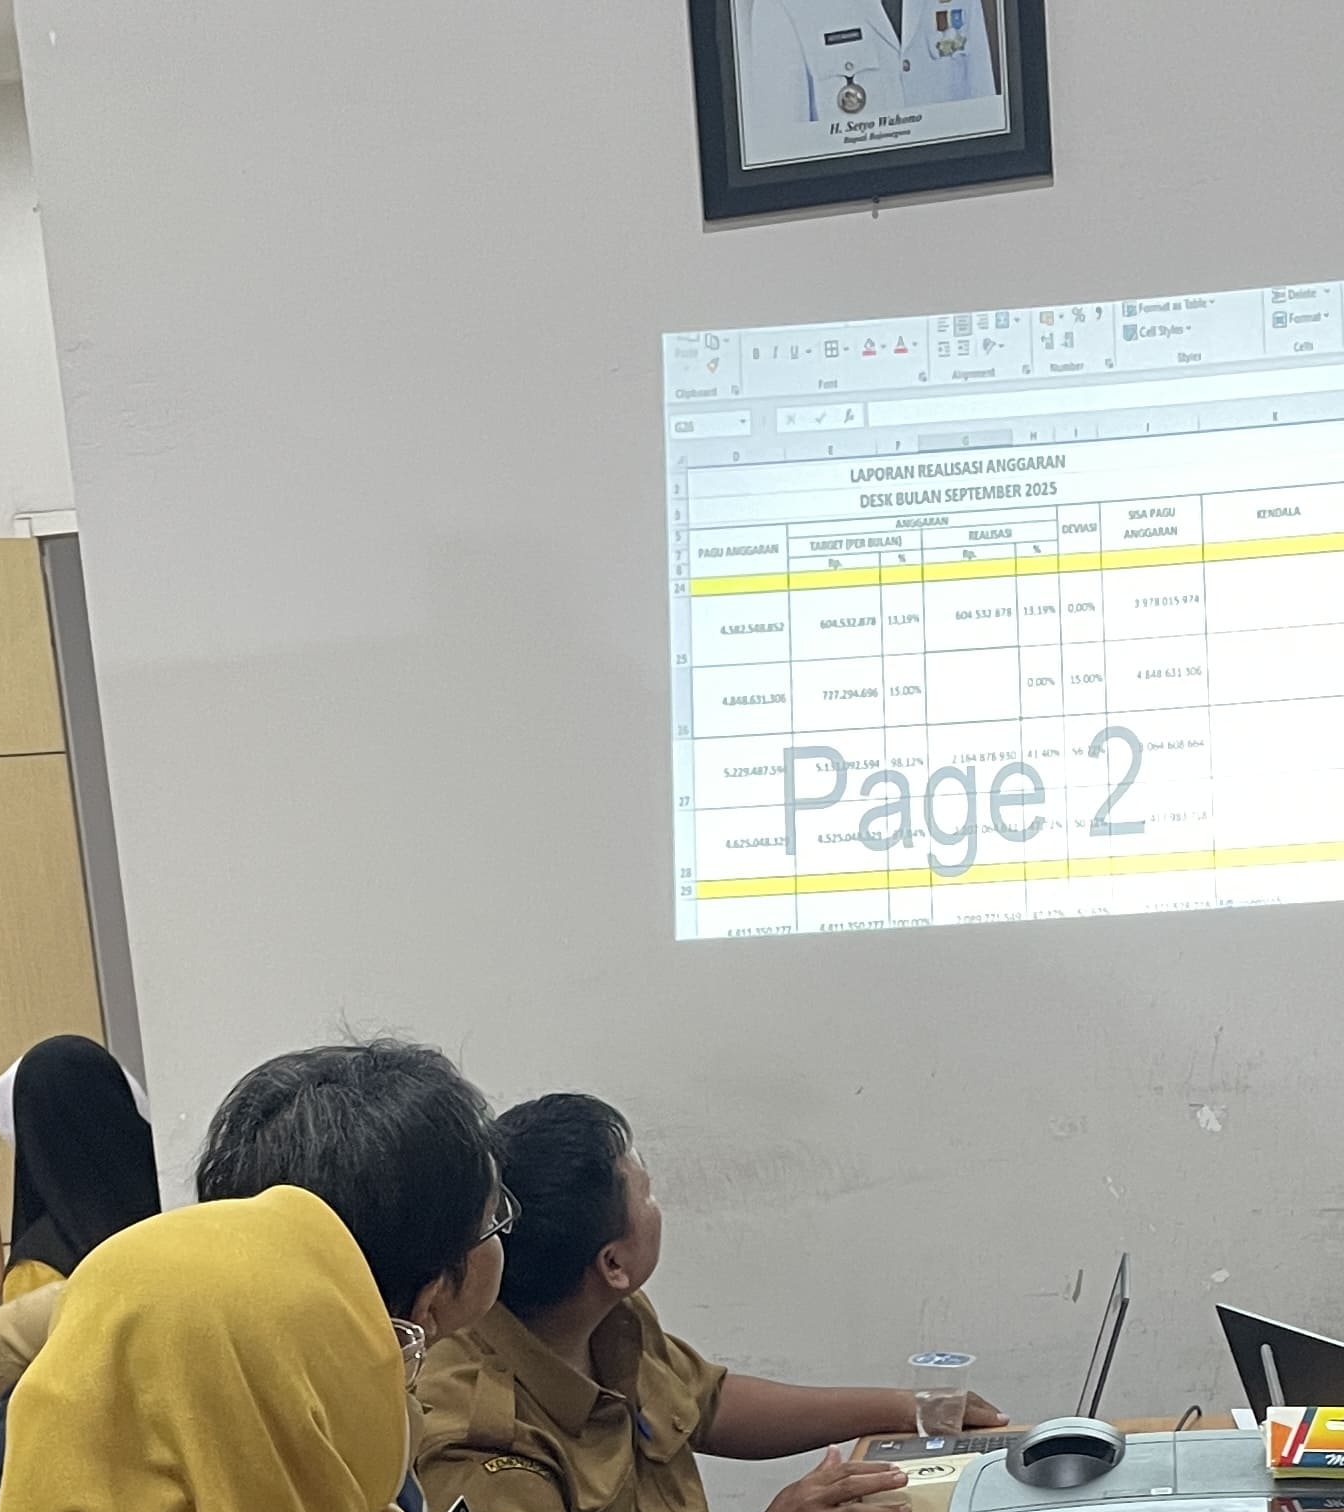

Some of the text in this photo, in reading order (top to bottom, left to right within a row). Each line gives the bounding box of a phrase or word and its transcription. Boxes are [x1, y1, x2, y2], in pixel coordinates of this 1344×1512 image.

[850, 454, 1066, 483] LAPORAN REALISASI ANGGARAN
[859, 481, 1058, 509] DESK BULAN SEPTEMBER 2025
[1128, 508, 1176, 520] SISA PAGU
[1257, 507, 1301, 519] KENDALA
[895, 517, 949, 529] ANGGARAN
[1062, 523, 1098, 534] DEVIASI
[969, 529, 1013, 541] REALISASI
[1124, 527, 1177, 540] ANGGARAN
[698, 544, 779, 559] PAGU ANGGARAN
[810, 539, 843, 552] TARGET
[782, 726, 1146, 878] Page 2
